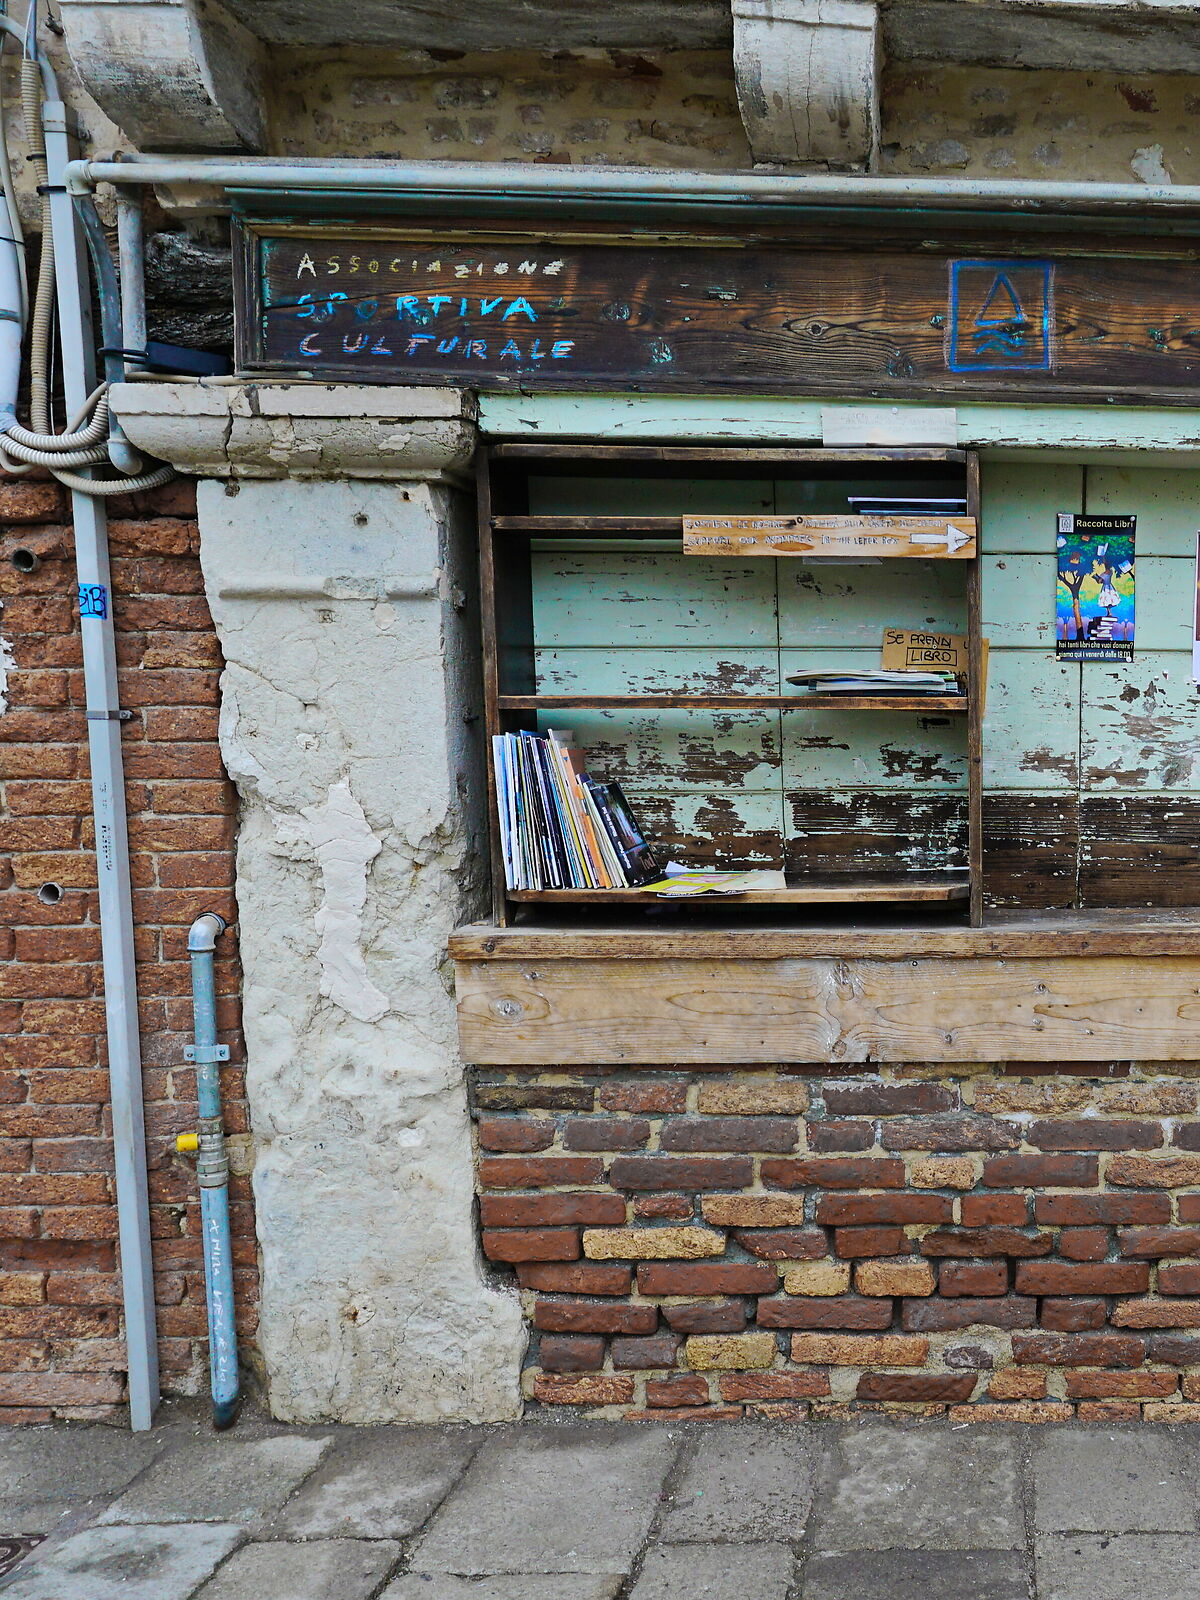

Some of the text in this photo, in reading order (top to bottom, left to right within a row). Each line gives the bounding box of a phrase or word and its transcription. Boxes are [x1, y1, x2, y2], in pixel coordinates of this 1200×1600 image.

[297, 252, 564, 279] ASSOCIAZIONE
[297, 292, 537, 323] SPORTIVA
[299, 333, 576, 361] CULTURALE
[1076, 519, 1134, 528] Raccolta Libri
[887, 630, 904, 645] SE
[910, 633, 952, 648] PRENDI
[911, 650, 952, 662] LIBRO
